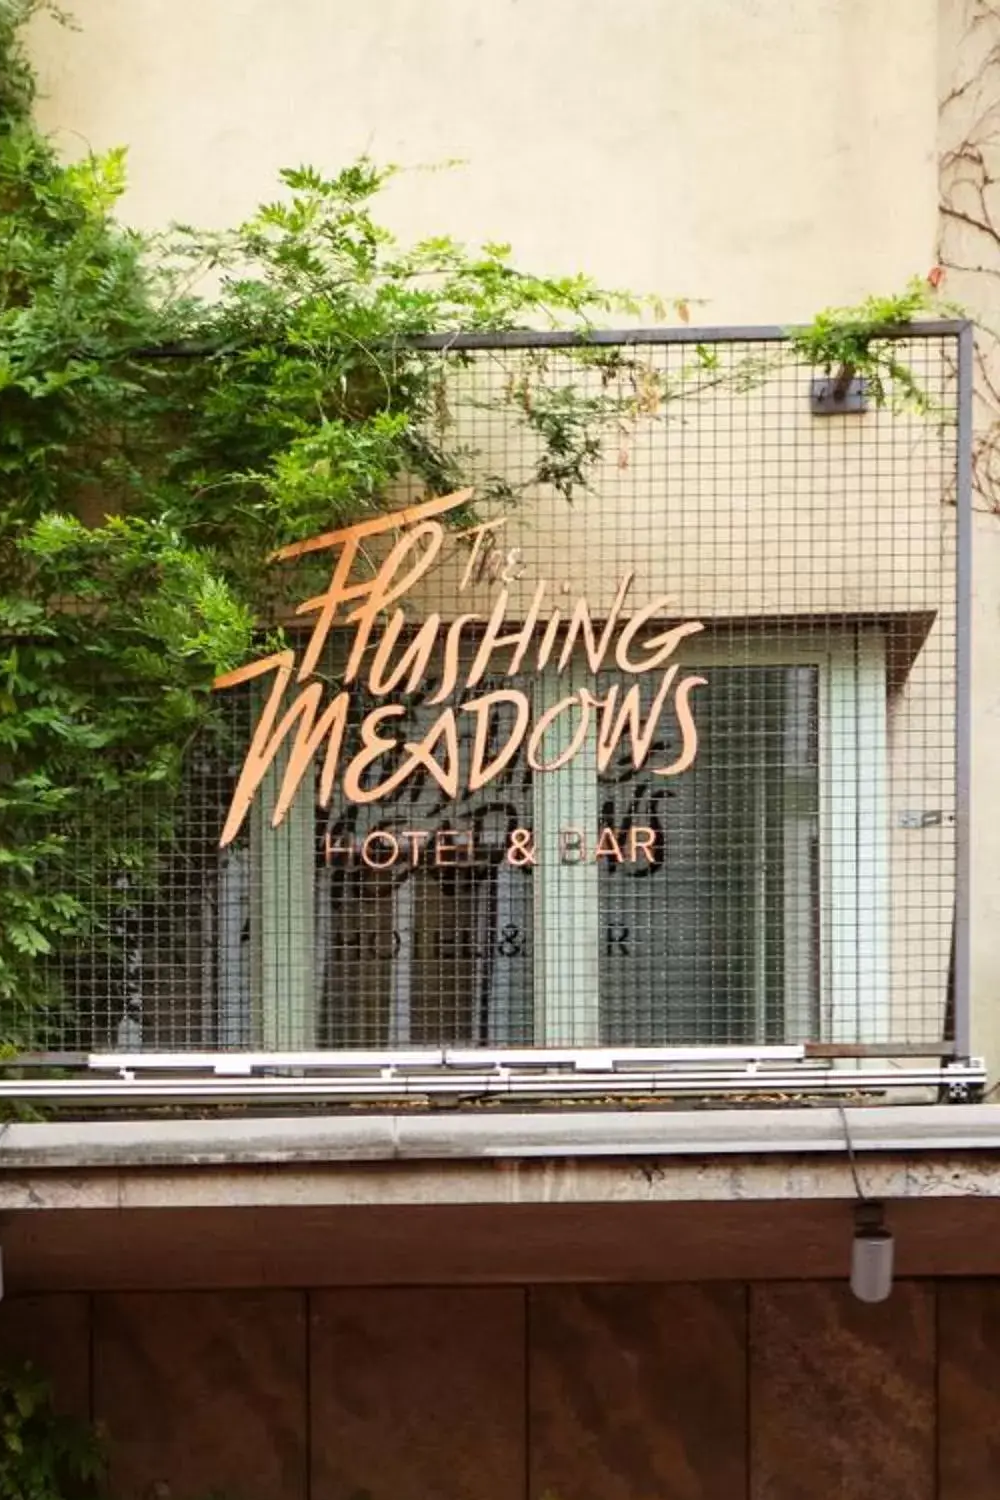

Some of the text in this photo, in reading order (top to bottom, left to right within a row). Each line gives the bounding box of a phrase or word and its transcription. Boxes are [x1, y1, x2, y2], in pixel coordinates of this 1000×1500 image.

[213, 649, 708, 848] MEADOWS
[507, 828, 537, 865] &
[559, 827, 657, 865] BAR
